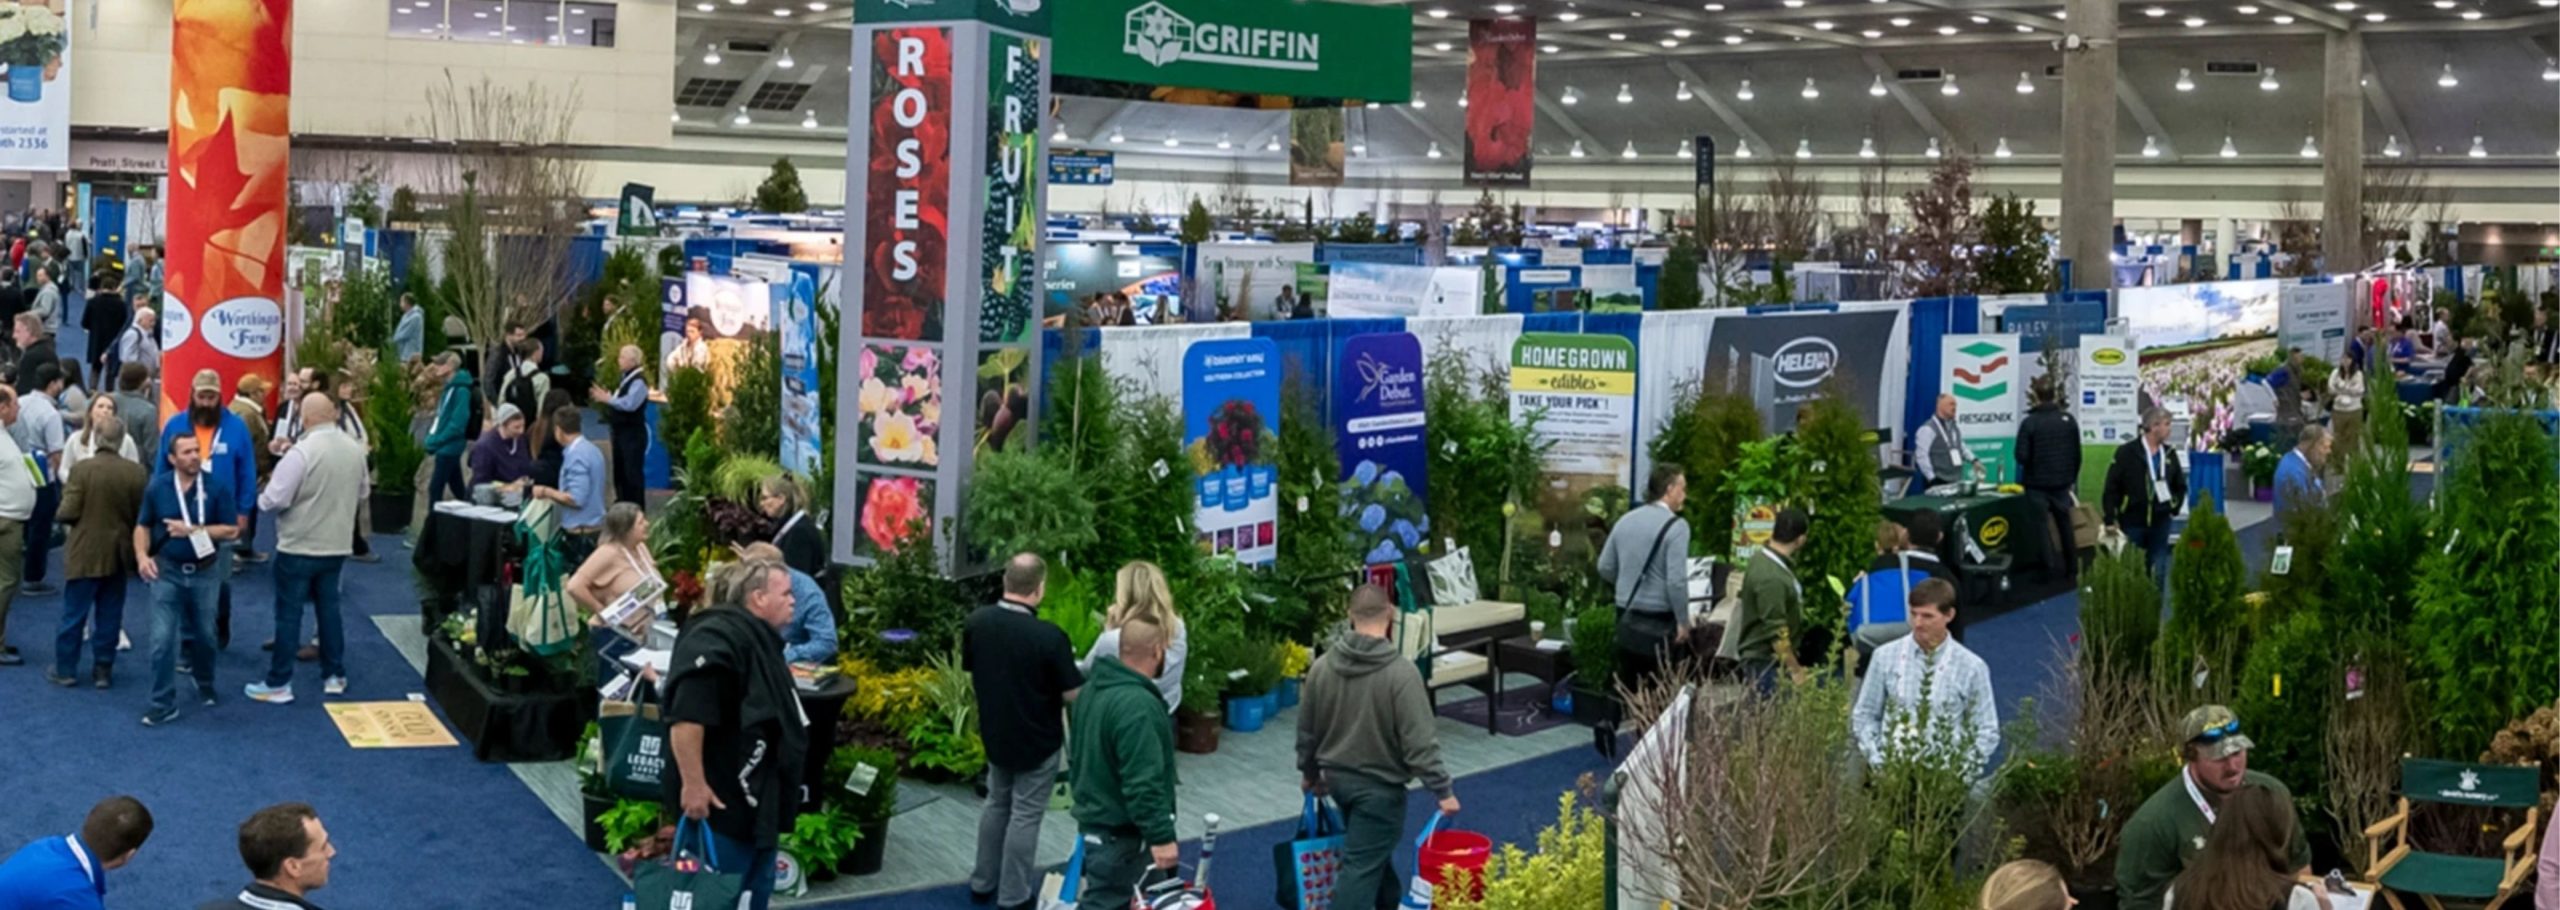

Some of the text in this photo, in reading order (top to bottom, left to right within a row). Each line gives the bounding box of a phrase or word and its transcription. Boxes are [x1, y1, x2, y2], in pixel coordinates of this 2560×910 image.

[1196, 23, 1319, 60] GRIFFIN
[19, 137, 48, 149] 2336
[89, 156, 116, 168] Pratt
[121, 158, 156, 169] Street
[893, 38, 927, 280] ROSES
[1000, 45, 1022, 282] FRUIT
[229, 329, 271, 350] Farms
[1521, 346, 1627, 370] HOMEGROWN
[1777, 351, 1831, 373] HELENA
[1380, 366, 1416, 384] Garden
[1550, 373, 1597, 391] edibles
[1518, 394, 1542, 407] TAKE
[1546, 396, 1572, 409] YOUR
[1959, 411, 2013, 424] RESGENIX
[627, 753, 666, 770] LEGACY
